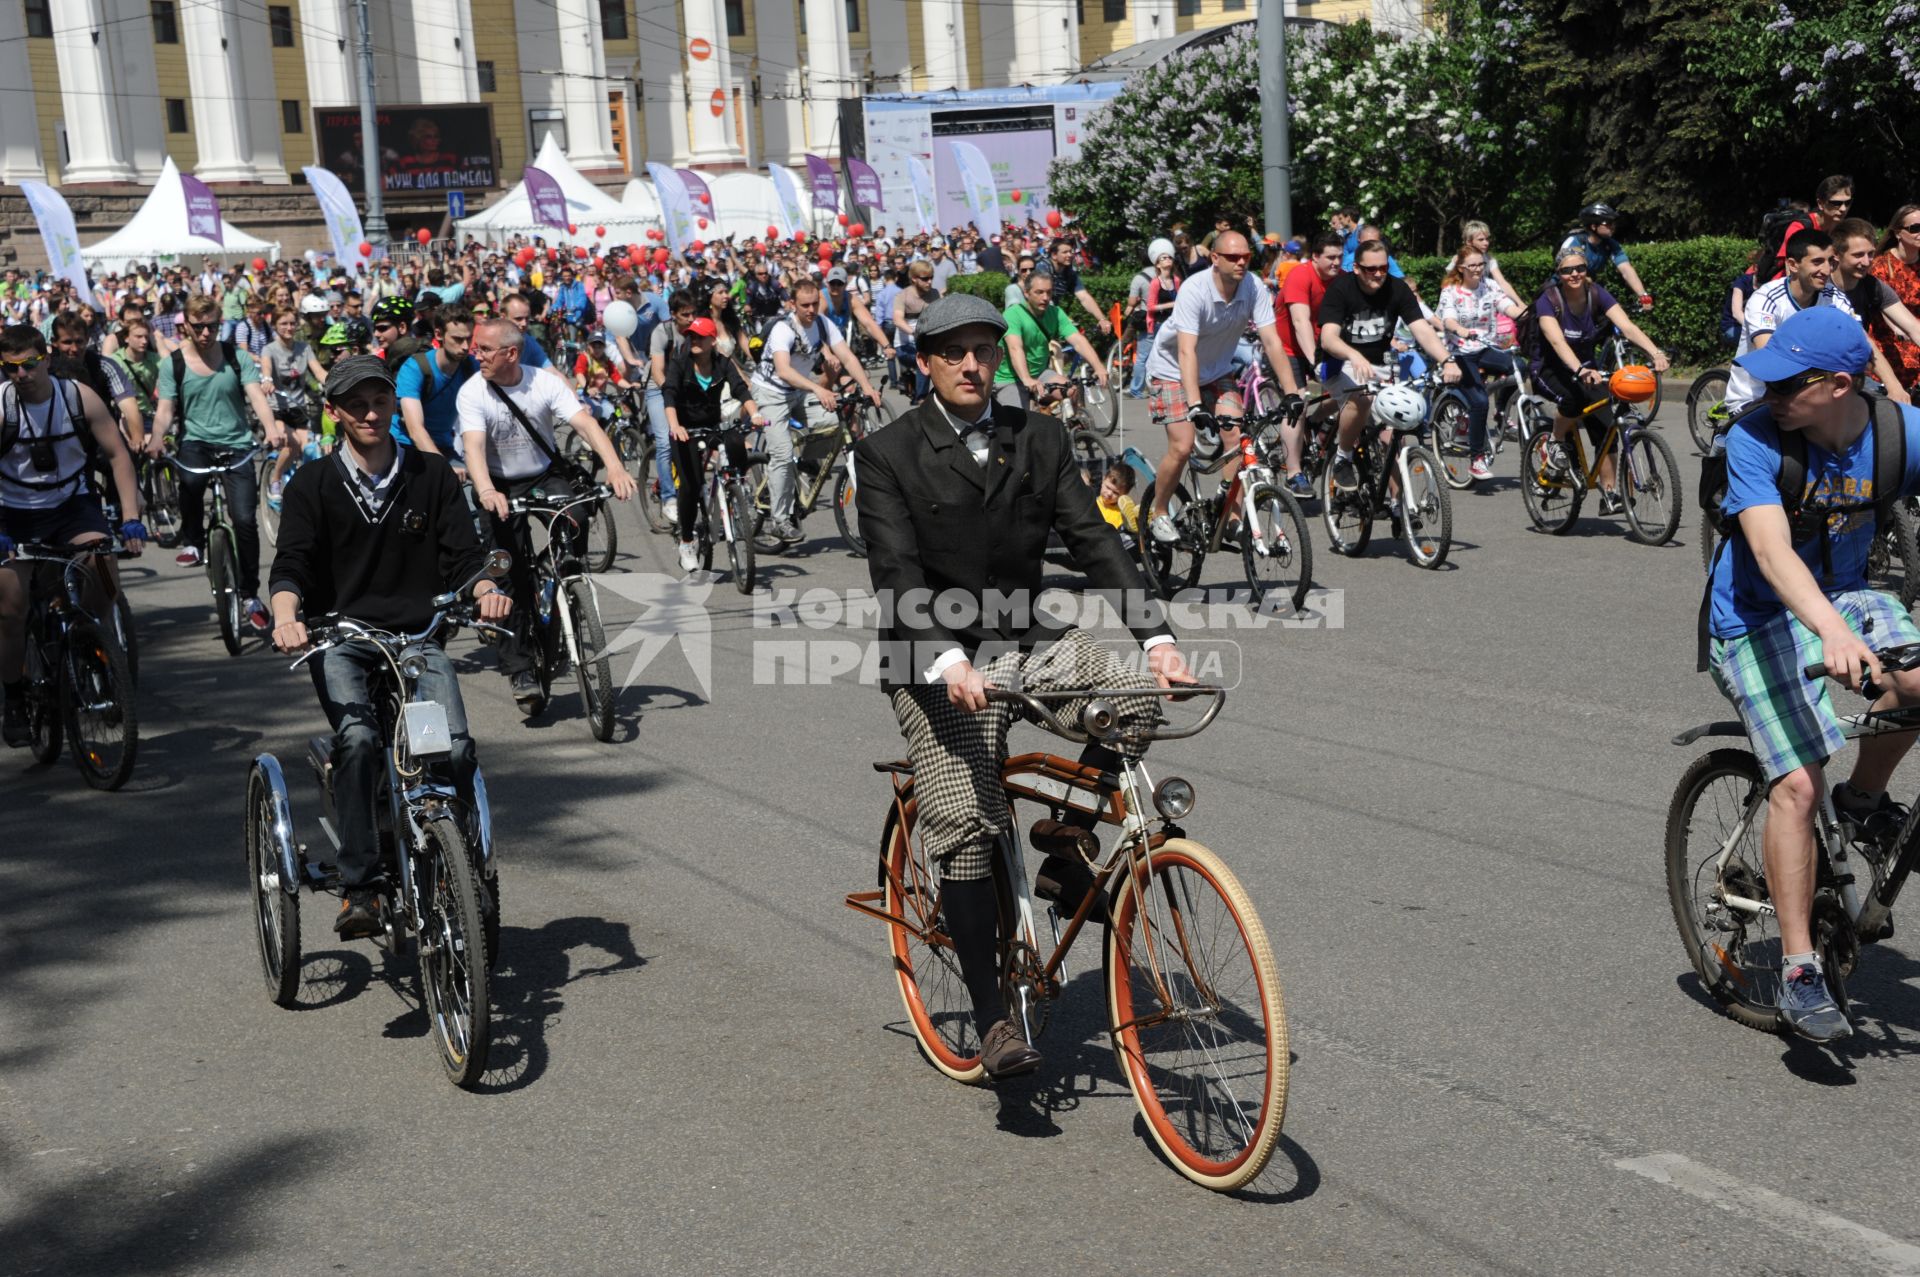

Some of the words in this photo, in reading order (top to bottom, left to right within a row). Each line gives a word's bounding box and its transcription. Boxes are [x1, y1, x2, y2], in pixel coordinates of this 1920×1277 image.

[326, 115, 392, 126] ПРЕМРА
[385, 173, 413, 189] МУЖ
[416, 172, 440, 189] ДЛЯ
[443, 170, 493, 187] ПАМЕЛЫ
